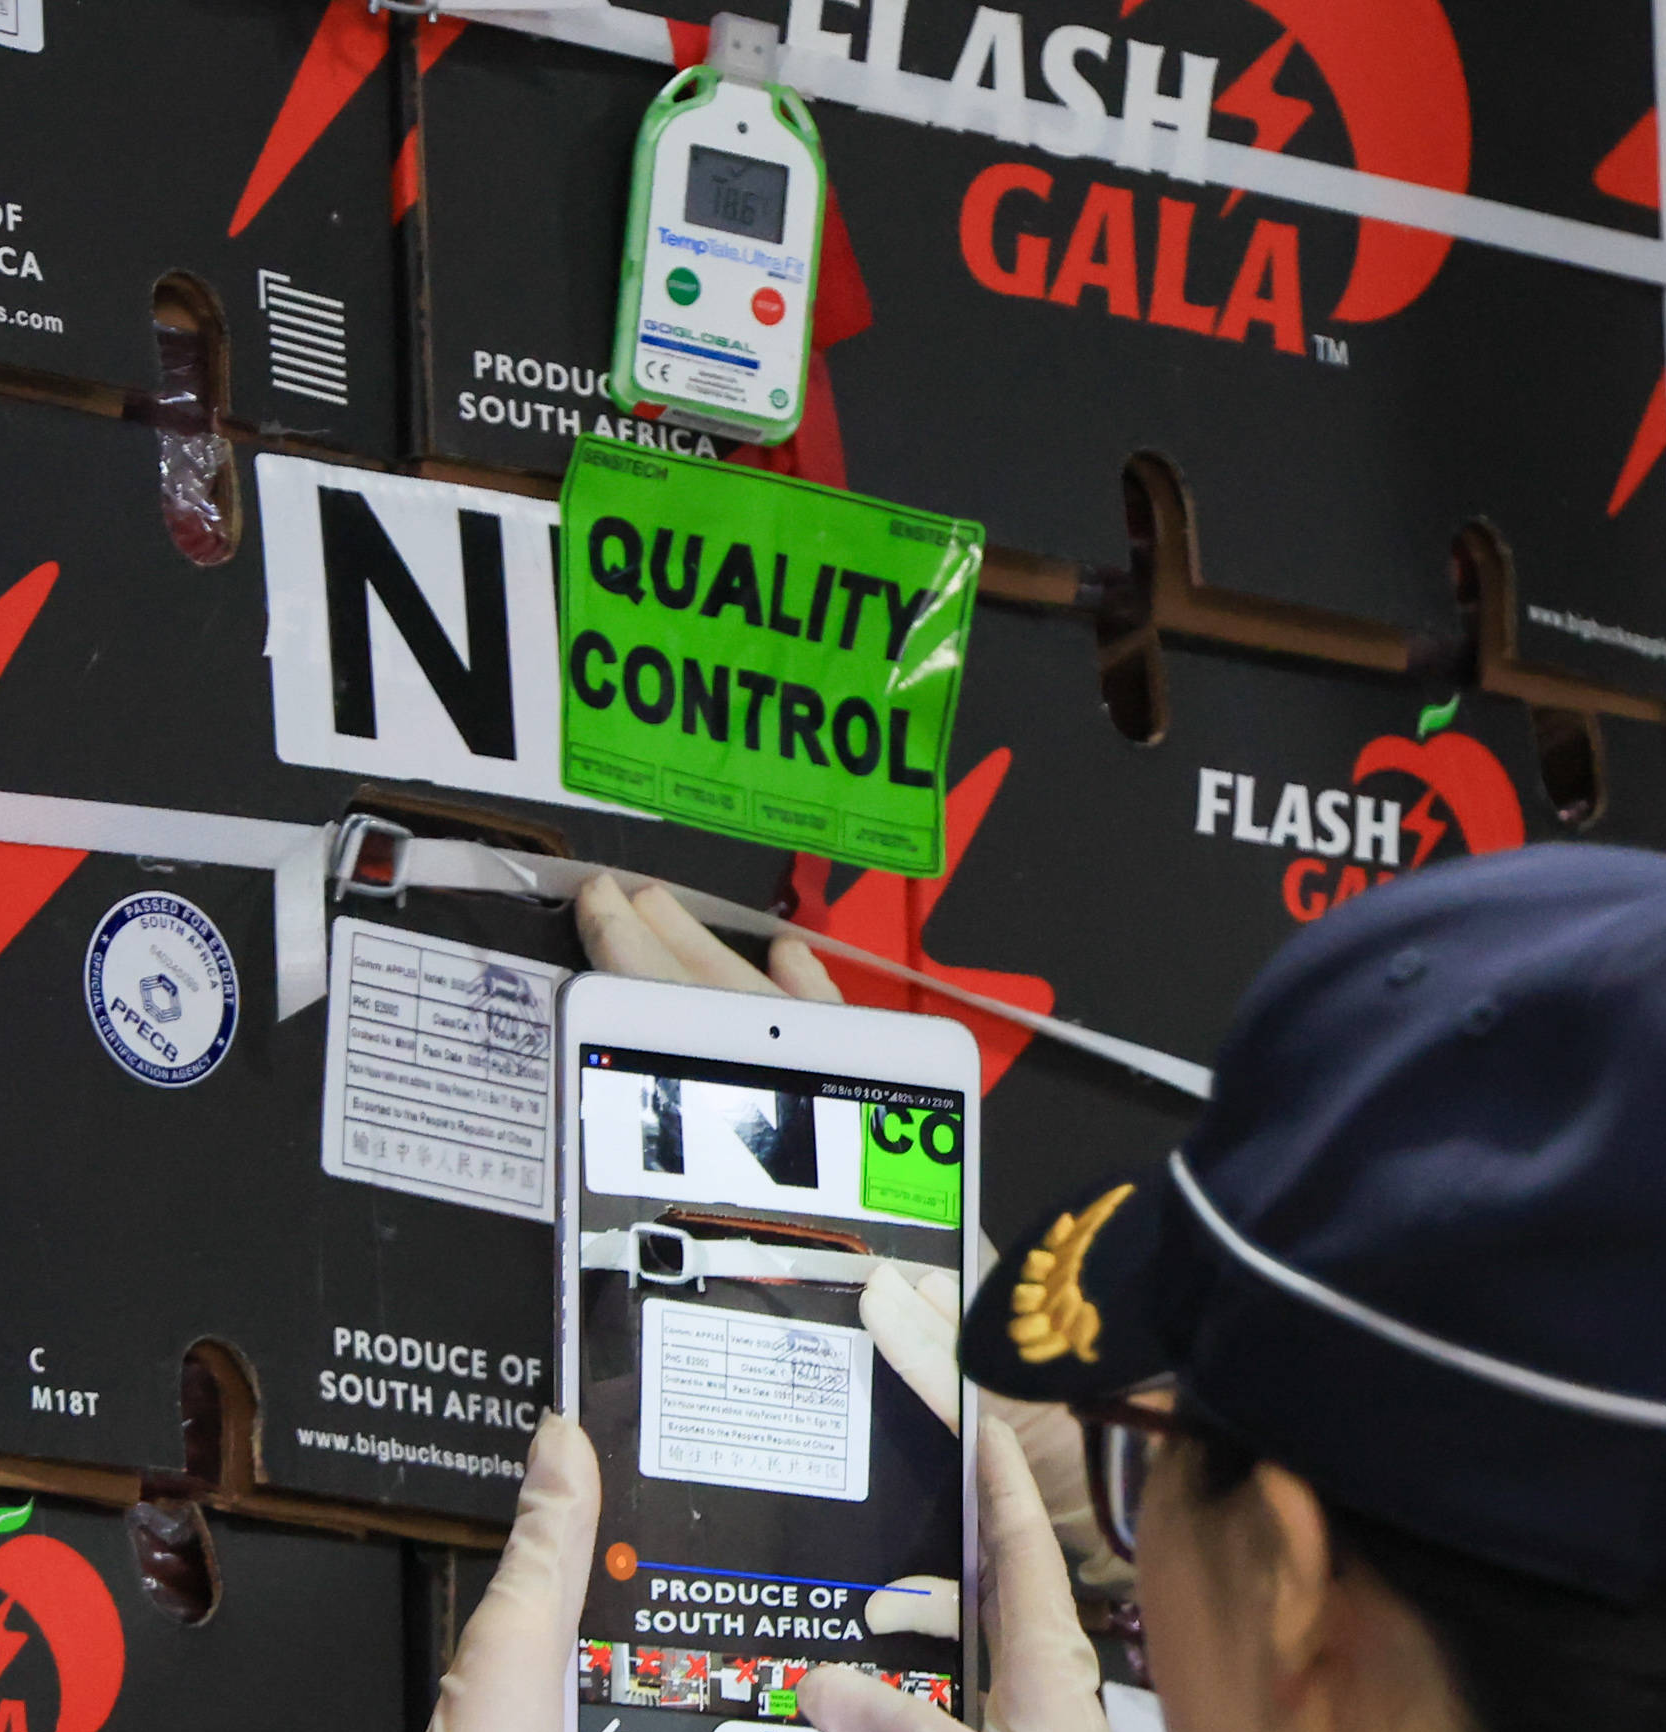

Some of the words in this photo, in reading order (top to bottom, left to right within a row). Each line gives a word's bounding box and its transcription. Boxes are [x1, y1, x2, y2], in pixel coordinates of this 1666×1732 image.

[959, 163, 1307, 357] GALA
[473, 350, 611, 398] PRODUC
[1312, 334, 1349, 367] TM
[458, 391, 581, 437] SOUTH
[594, 414, 718, 460] AFRICA
[588, 515, 939, 663] QUALITY
[318, 484, 561, 761] N
[570, 629, 935, 789] CONTROL
[1194, 766, 1402, 867] FLASH
[1282, 857, 1395, 923] GA
[123, 899, 179, 919] PASSED
[182, 907, 209, 938] FOR
[207, 931, 235, 1004] EXPORT
[140, 917, 185, 937] SOUTH
[187, 934, 220, 990] AFRICA
[110, 997, 179, 1063] PPECB
[29, 1346, 45, 1374] C
[333, 1326, 488, 1380] PRODUCE
[499, 1353, 542, 1387] OF
[31, 1385, 99, 1419] M18T
[319, 1369, 434, 1416] SOUTH
[296, 1427, 526, 1480] www.bigbucksapples
[634, 1608, 744, 1637] SOUTH
[754, 1615, 864, 1642] AFRICA
[650, 1578, 798, 1608] PRODUCE
[808, 1586, 848, 1610] OF
